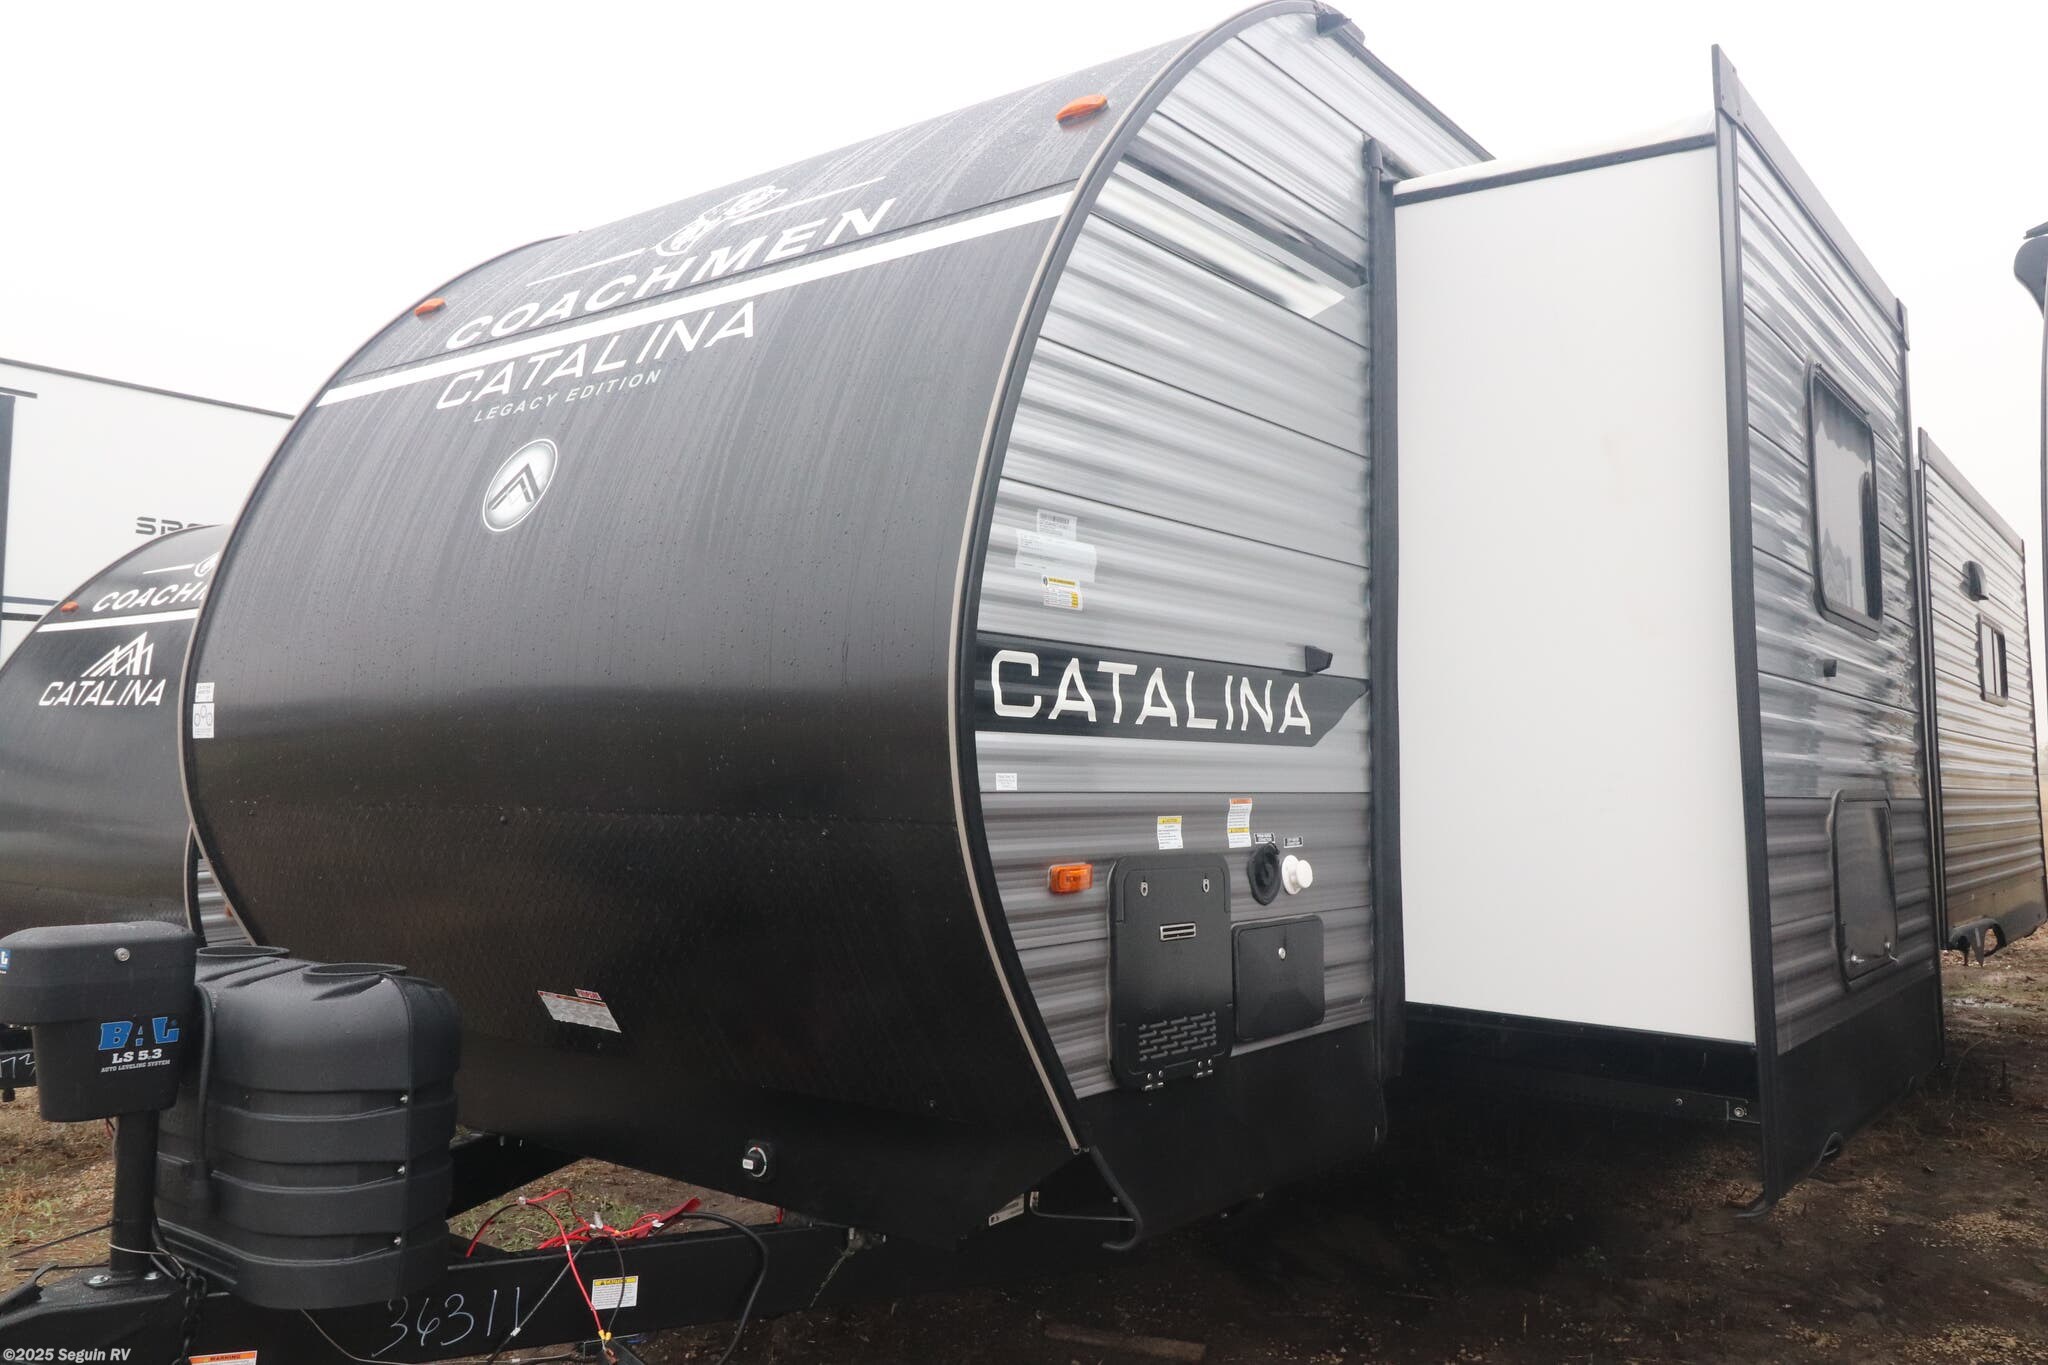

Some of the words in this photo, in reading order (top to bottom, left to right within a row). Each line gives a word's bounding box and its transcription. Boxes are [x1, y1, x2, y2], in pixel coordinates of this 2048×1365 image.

[446, 197, 897, 350] COACHMEN
[436, 301, 754, 410] CATALINA
[473, 392, 558, 423] LEGACY
[565, 369, 662, 402] EDITION
[135, 516, 204, 536] SP
[38, 679, 166, 706] CATALINA
[990, 649, 1312, 736] CATALINA
[101, 1065, 117, 1073] AUTO
[118, 1062, 146, 1071] LEVELING
[147, 1058, 171, 1067] SYSTEM
[111, 1051, 135, 1064] LS
[138, 1048, 162, 1061] 5.3
